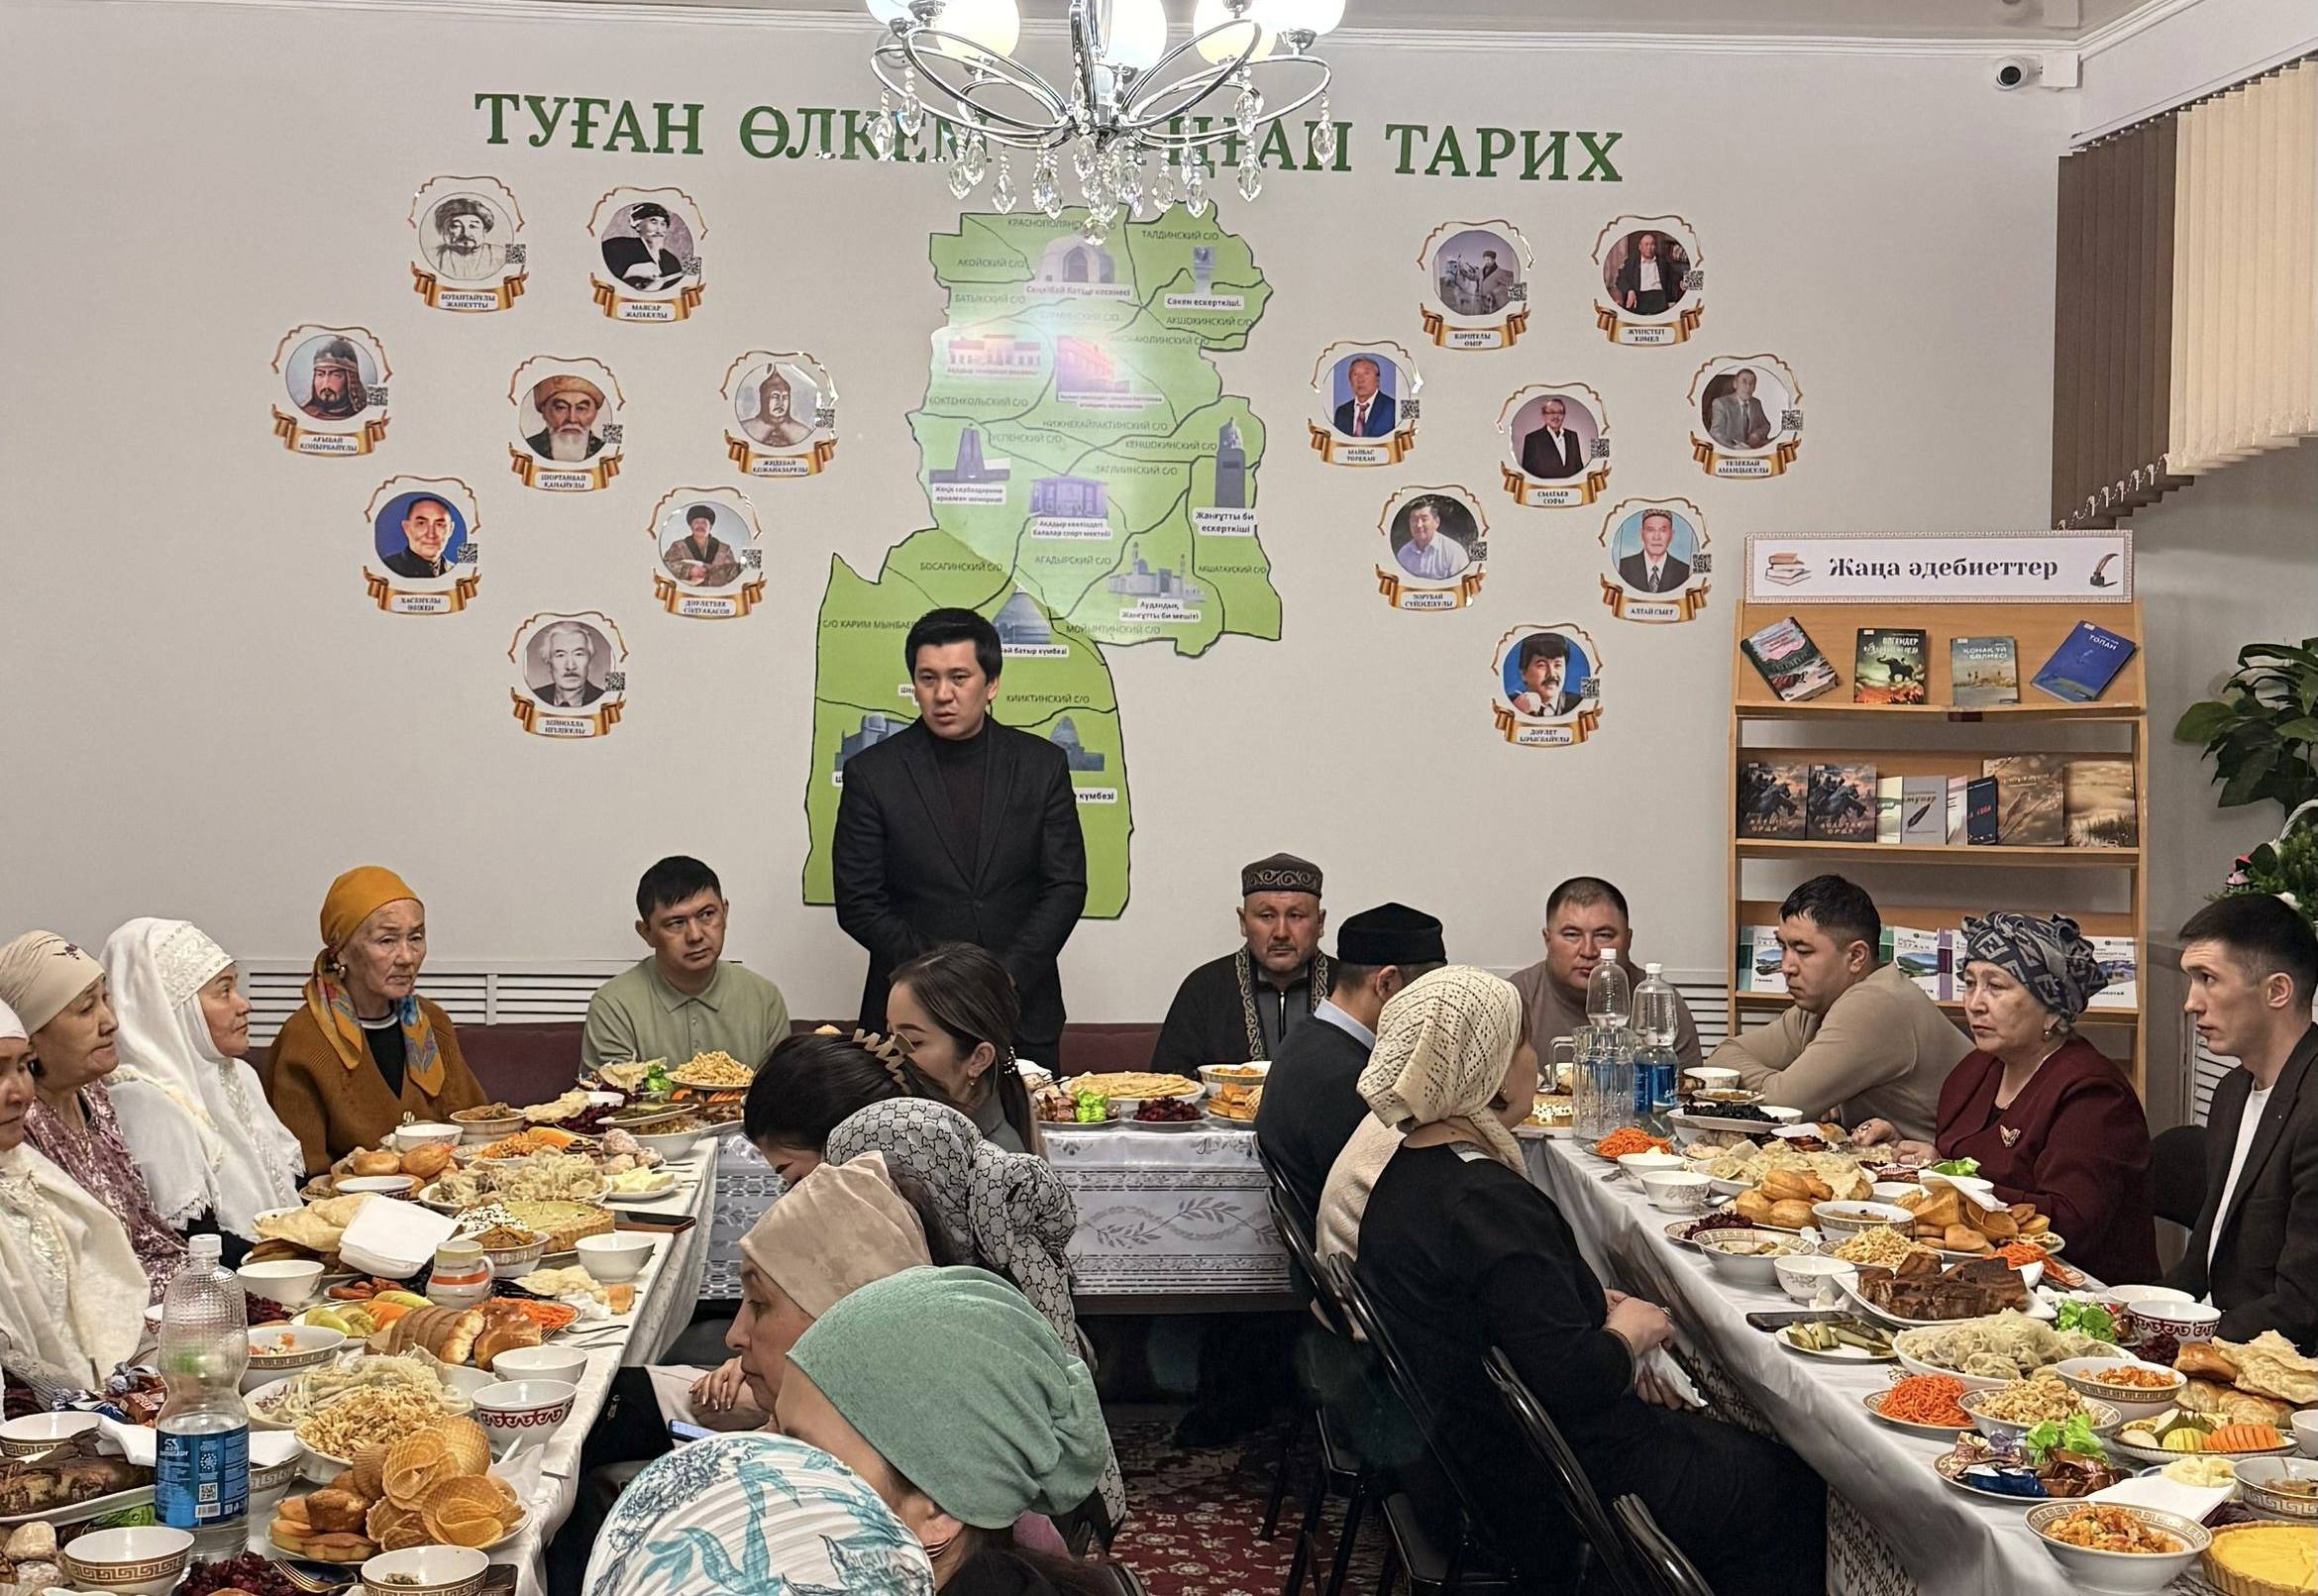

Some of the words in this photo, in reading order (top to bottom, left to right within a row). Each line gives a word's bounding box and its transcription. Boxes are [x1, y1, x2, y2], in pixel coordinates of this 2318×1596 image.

[474, 93, 704, 156] ТУҒАН
[1384, 123, 1624, 182] ТАРИХ
[1142, 230, 1202, 241] ТАЛДИНСКИЙ
[1204, 232, 1219, 241] С/О
[958, 258, 1007, 268] АКОЙСКИЙ
[1008, 259, 1025, 268] С/О
[1167, 316, 1235, 327] АКШОКИНСКИЙ
[1011, 397, 1028, 408] С/О
[1152, 421, 1168, 431] С/О
[1162, 467, 1178, 476] С/О
[1242, 511, 1254, 520] би
[1202, 524, 1250, 534] ескерткіші
[1035, 555, 1095, 566] АГАДЫРСКИЙ
[1096, 556, 1111, 566] С/О
[920, 562, 985, 572] БОСАГИНСКИЙ
[1198, 565, 1252, 574] АКШАТАУСКИЙ
[1830, 558, 1901, 581] Жаңа
[1909, 557, 2059, 581] әдебиеттер
[823, 619, 838, 629] С/О
[841, 620, 872, 629] КАРИМ
[1145, 625, 1161, 635] С/О
[2089, 635, 2117, 651] ТОПАН
[1006, 693, 1073, 703] КИИКТИНСКИЙ
[1079, 792, 1114, 801] күмбезі
